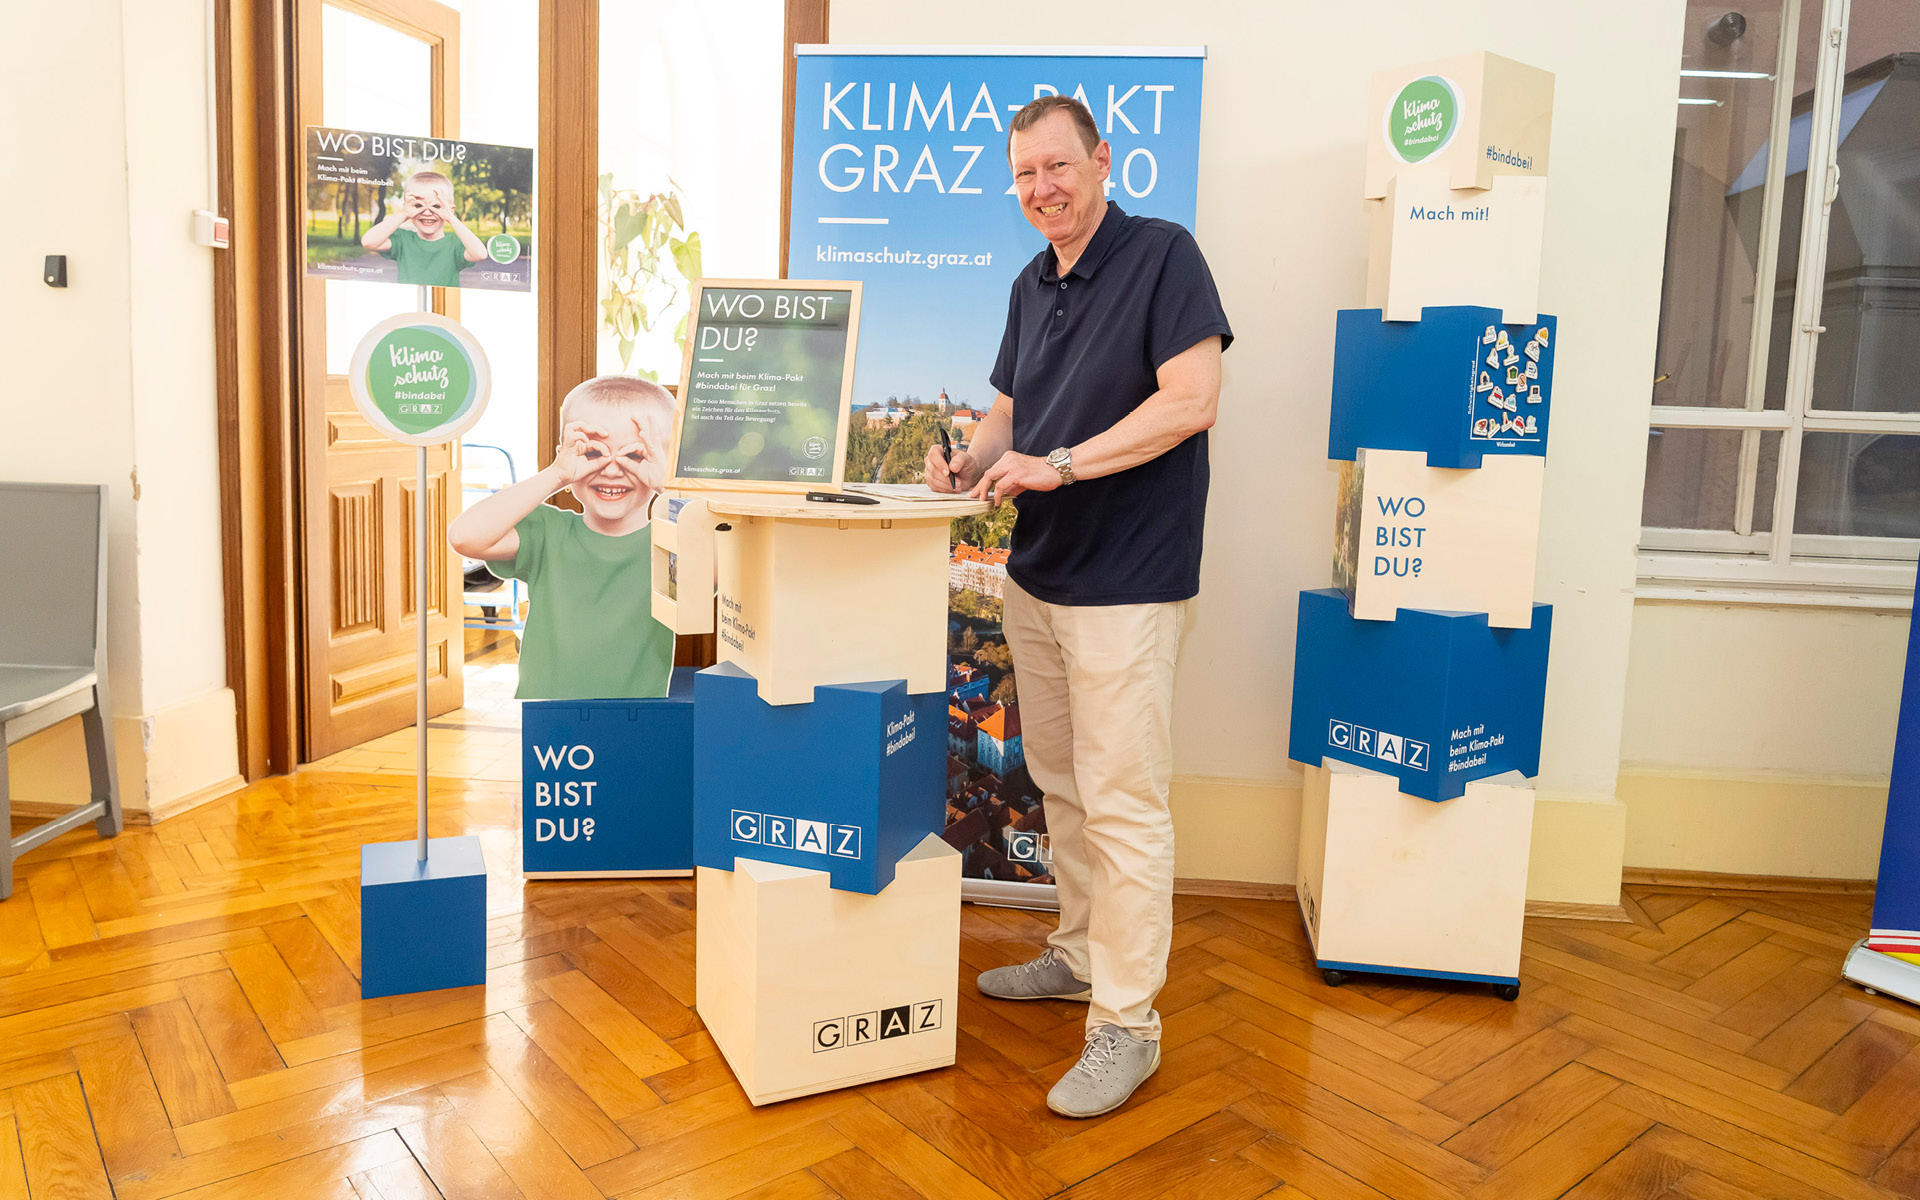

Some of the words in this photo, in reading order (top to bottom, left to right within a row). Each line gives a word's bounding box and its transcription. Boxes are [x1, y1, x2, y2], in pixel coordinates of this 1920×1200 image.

[822, 80, 1175, 135] KLIMA-KT
[1404, 111, 1443, 136] schutz
[316, 130, 365, 155] WO
[372, 136, 417, 159] BIST
[423, 141, 467, 165] DU?
[1404, 134, 1440, 146] #bindabei
[818, 142, 985, 195] GRAZ
[1486, 145, 1533, 170] #bindabei!
[317, 164, 337, 172] Mach
[351, 166, 368, 174] beim
[317, 174, 356, 184] Klima-Pakt
[1409, 205, 1455, 220] Mach
[1461, 207, 1490, 221] mit!
[816, 244, 993, 269] klimaschutz.graz.at
[317, 262, 383, 274] klimaschutz.graz.at
[482, 272, 519, 281] GRAZ
[706, 293, 765, 318] WO
[774, 295, 833, 320] BIST
[700, 326, 758, 352] DU?
[394, 364, 450, 389] schutz
[695, 382, 737, 391] #bindabei
[739, 383, 751, 391] für
[752, 384, 776, 392] Graz!
[696, 371, 720, 380] Mach
[721, 372, 735, 380] mit
[736, 372, 756, 380] beim
[758, 373, 804, 382] Klima-Pakt
[394, 391, 446, 400] #bindabei
[400, 404, 441, 414] GRAZ
[683, 466, 741, 474] klimaschutz.graz.at
[790, 468, 823, 476] GRAZ
[1377, 496, 1426, 518] WO
[1376, 526, 1427, 548] BIST
[1374, 556, 1423, 578] DU?
[722, 594, 734, 610] Mach
[722, 609, 732, 626] beim
[733, 616, 756, 640] Klima-Pakt
[886, 710, 915, 738] Klima-Pakt
[1451, 726, 1472, 741] Mach
[1473, 724, 1484, 736] mit
[886, 727, 916, 757] #bindabei!
[1331, 724, 1424, 768] GRAZ
[1449, 741, 1468, 756] beim
[1469, 734, 1504, 752] Klima-Pakt
[533, 744, 595, 771] WO
[1448, 755, 1487, 772] #bindabei!
[535, 781, 597, 807] BIST
[536, 817, 596, 843] DU?
[734, 815, 856, 856] GRAZ
[817, 1003, 937, 1048] GRAZ
